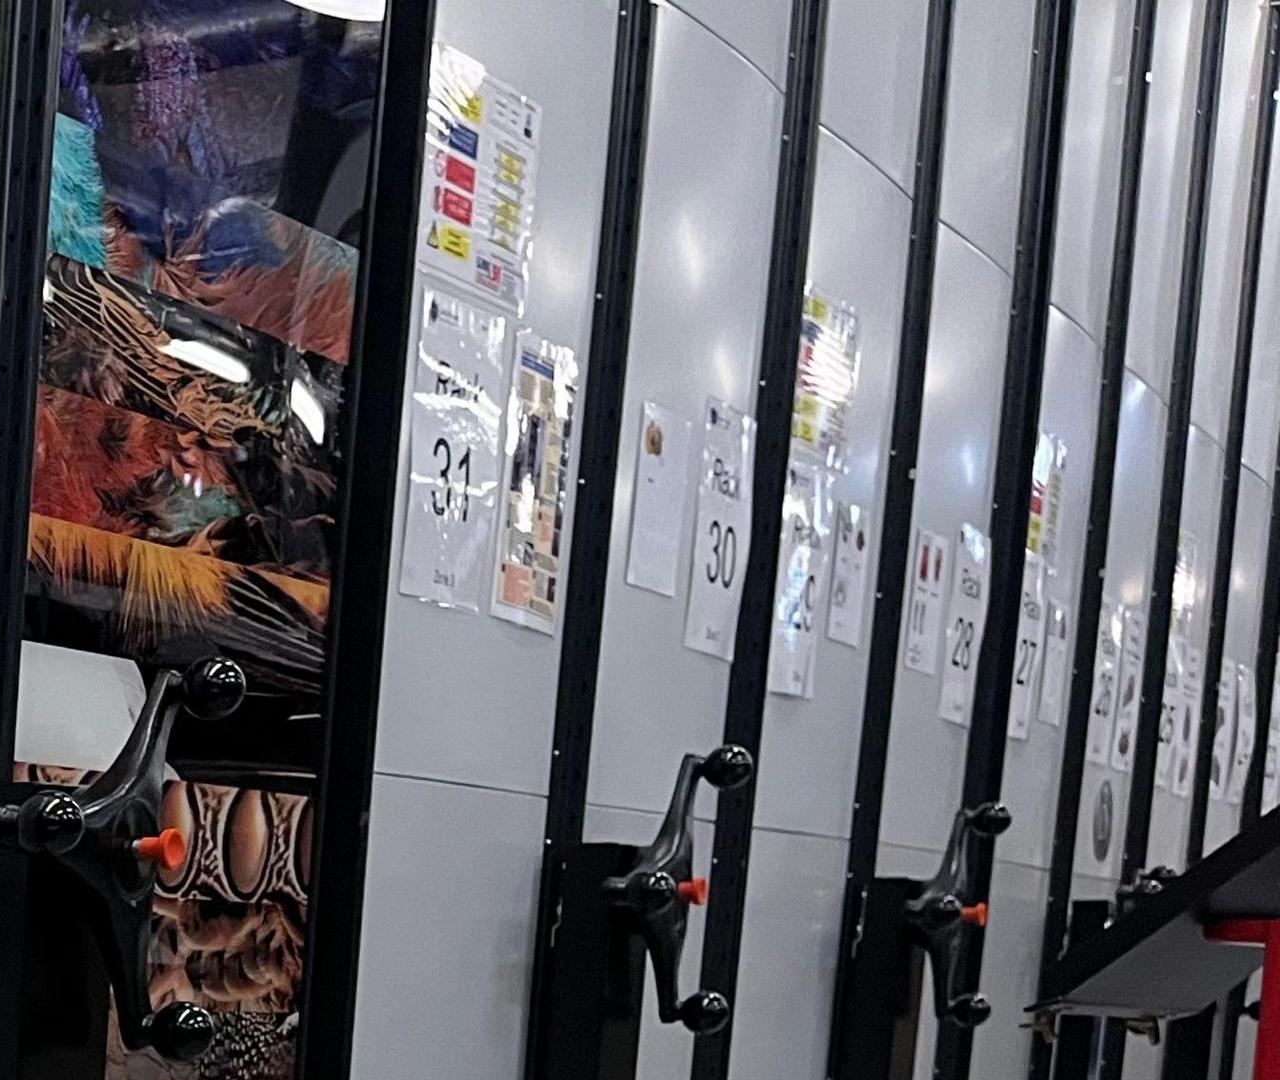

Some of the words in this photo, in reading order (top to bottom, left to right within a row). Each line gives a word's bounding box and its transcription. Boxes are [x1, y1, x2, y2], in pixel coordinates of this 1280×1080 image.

[706, 520, 737, 589] 30
[952, 617, 975, 671] 28
[1016, 638, 1038, 687] 27
